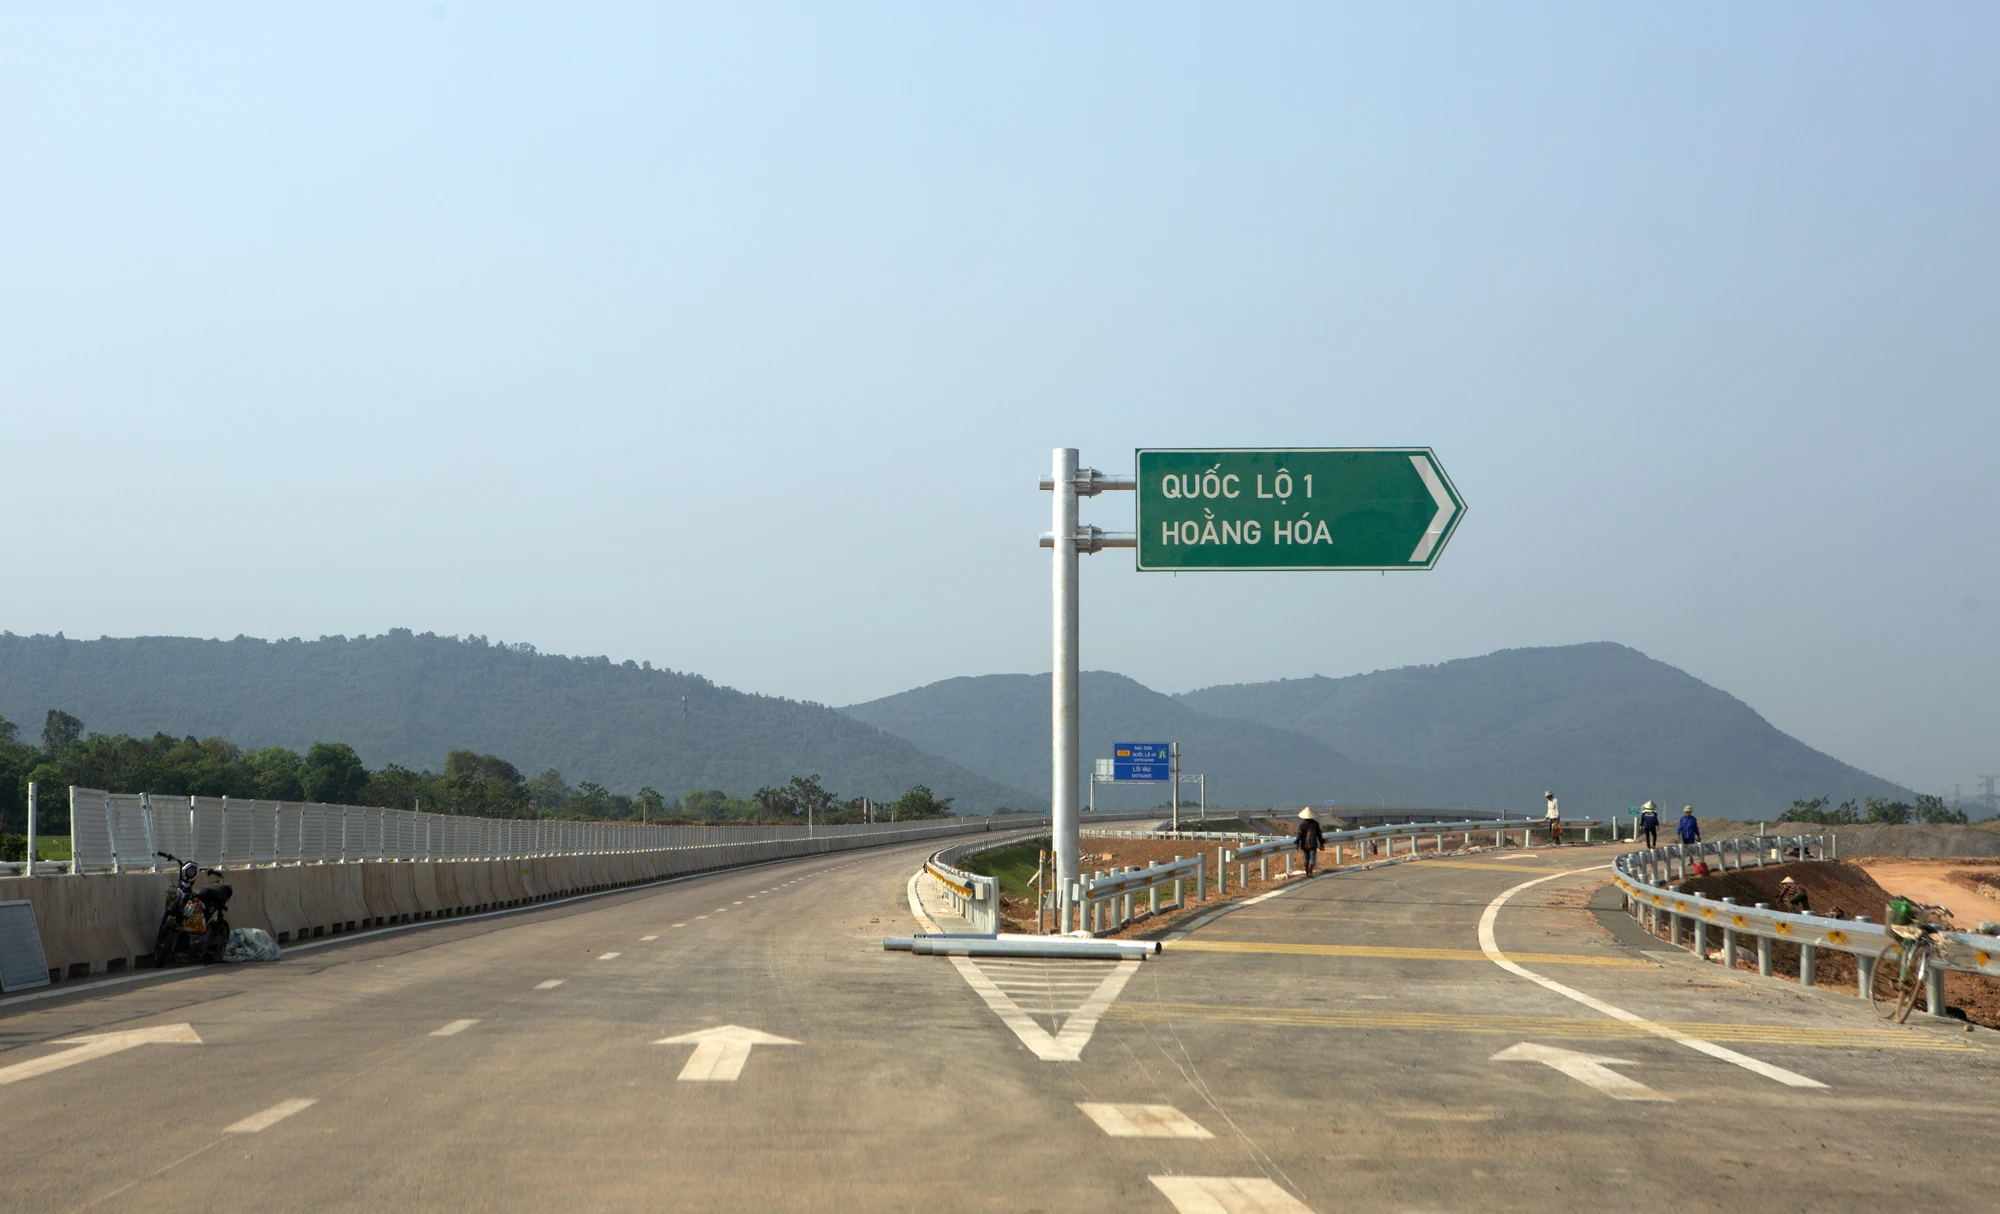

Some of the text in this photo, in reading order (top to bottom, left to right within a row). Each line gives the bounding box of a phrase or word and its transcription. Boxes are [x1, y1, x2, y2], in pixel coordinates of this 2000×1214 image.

[1162, 463, 1313, 505] QUỐC LỘ 1
[1162, 507, 1333, 545] HOẰNG HÓA
